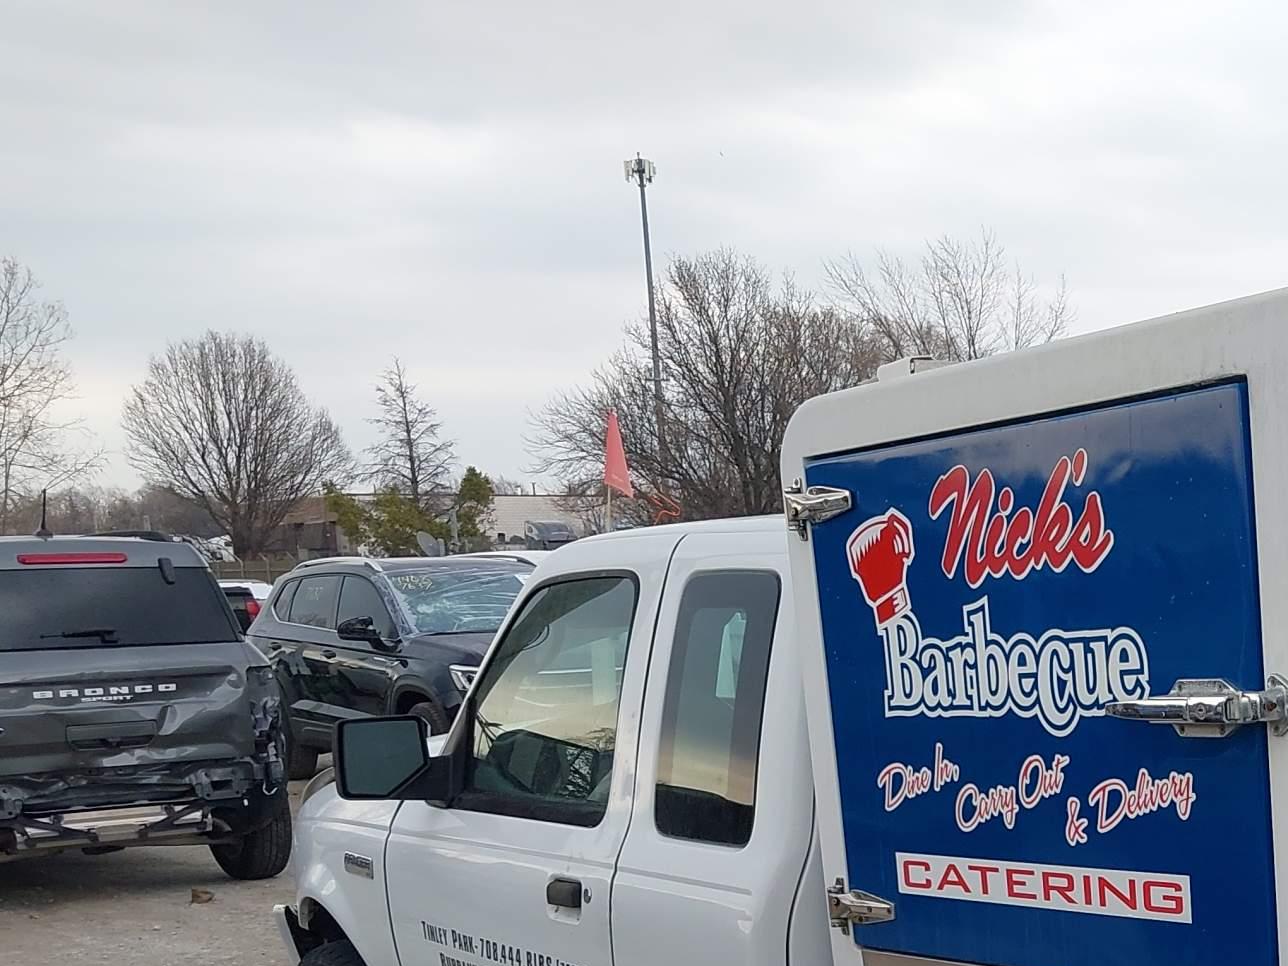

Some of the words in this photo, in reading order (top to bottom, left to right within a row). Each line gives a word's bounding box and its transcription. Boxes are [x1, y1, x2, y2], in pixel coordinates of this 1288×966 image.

[929, 448, 1114, 588] Nick's
[32, 683, 177, 699] BRONCO
[80, 695, 134, 703] SPORT
[885, 596, 1151, 737] Barbecue
[878, 763, 931, 811] Dine
[955, 783, 1019, 832] Carry
[1018, 754, 1070, 809] Out
[1065, 797, 1089, 846] &
[1089, 767, 1196, 833] Delivery
[903, 859, 1184, 916] CATERING
